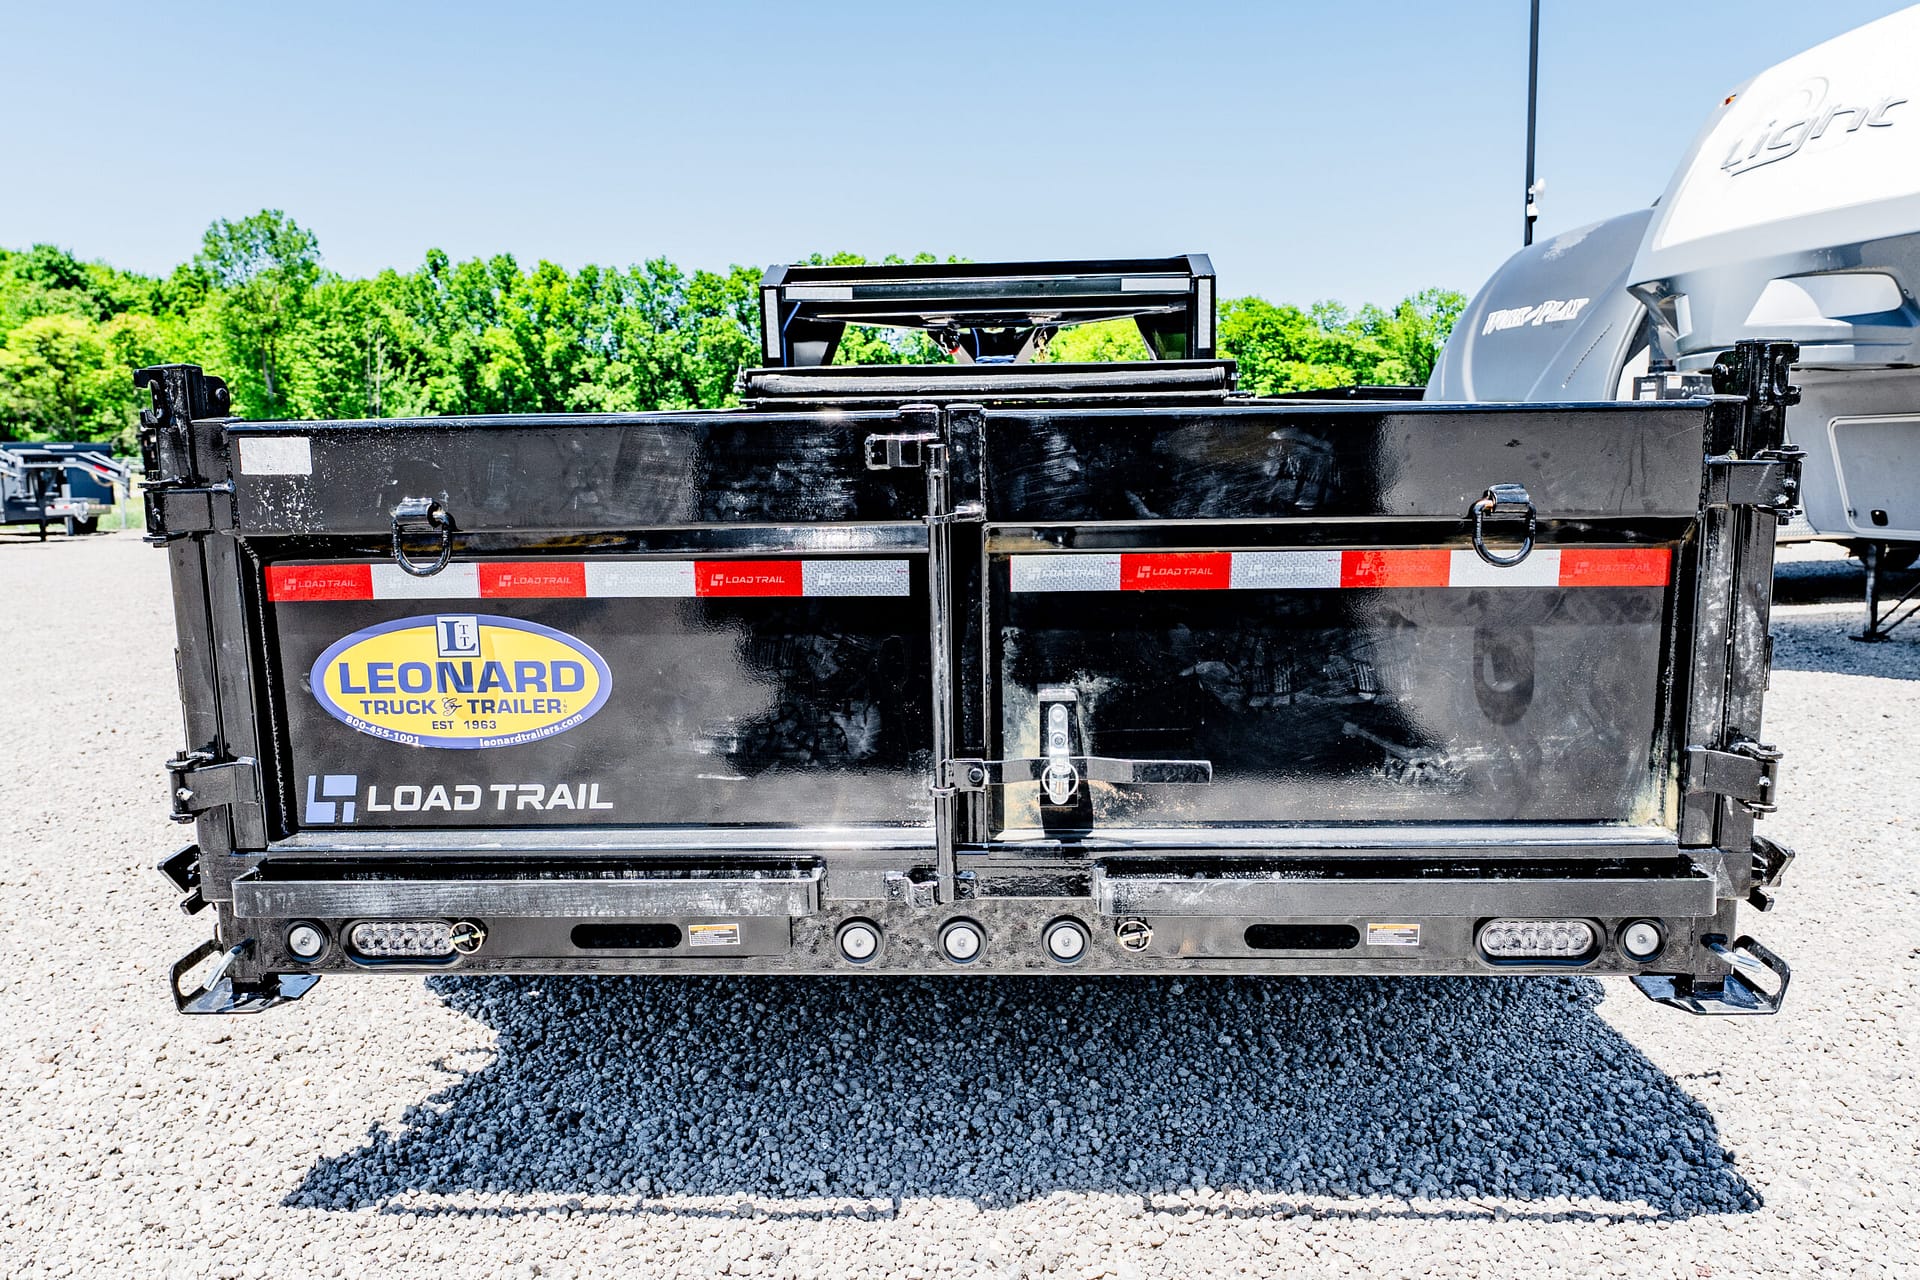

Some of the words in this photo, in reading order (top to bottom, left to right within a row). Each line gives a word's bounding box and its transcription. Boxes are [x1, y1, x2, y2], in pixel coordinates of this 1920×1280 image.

[1152, 568, 1182, 576] LOAD
[1183, 567, 1213, 575] TRAIL
[298, 579, 326, 588] LOAD
[326, 578, 356, 587] TRAIL
[513, 577, 542, 585] LOAD
[543, 576, 572, 584] TRAIL
[725, 576, 754, 584] LOAD
[755, 575, 785, 584] TRAIL
[338, 660, 586, 695] LEONARD
[360, 699, 437, 715] TRUCK
[467, 698, 562, 714] TRAILER
[345, 715, 420, 745] 800-455-1001
[432, 720, 455, 730] EST
[464, 720, 497, 730] 1963
[480, 713, 583, 748] leonardtrailers.com
[367, 785, 482, 812] LOAD
[489, 783, 614, 811] TRAIL
